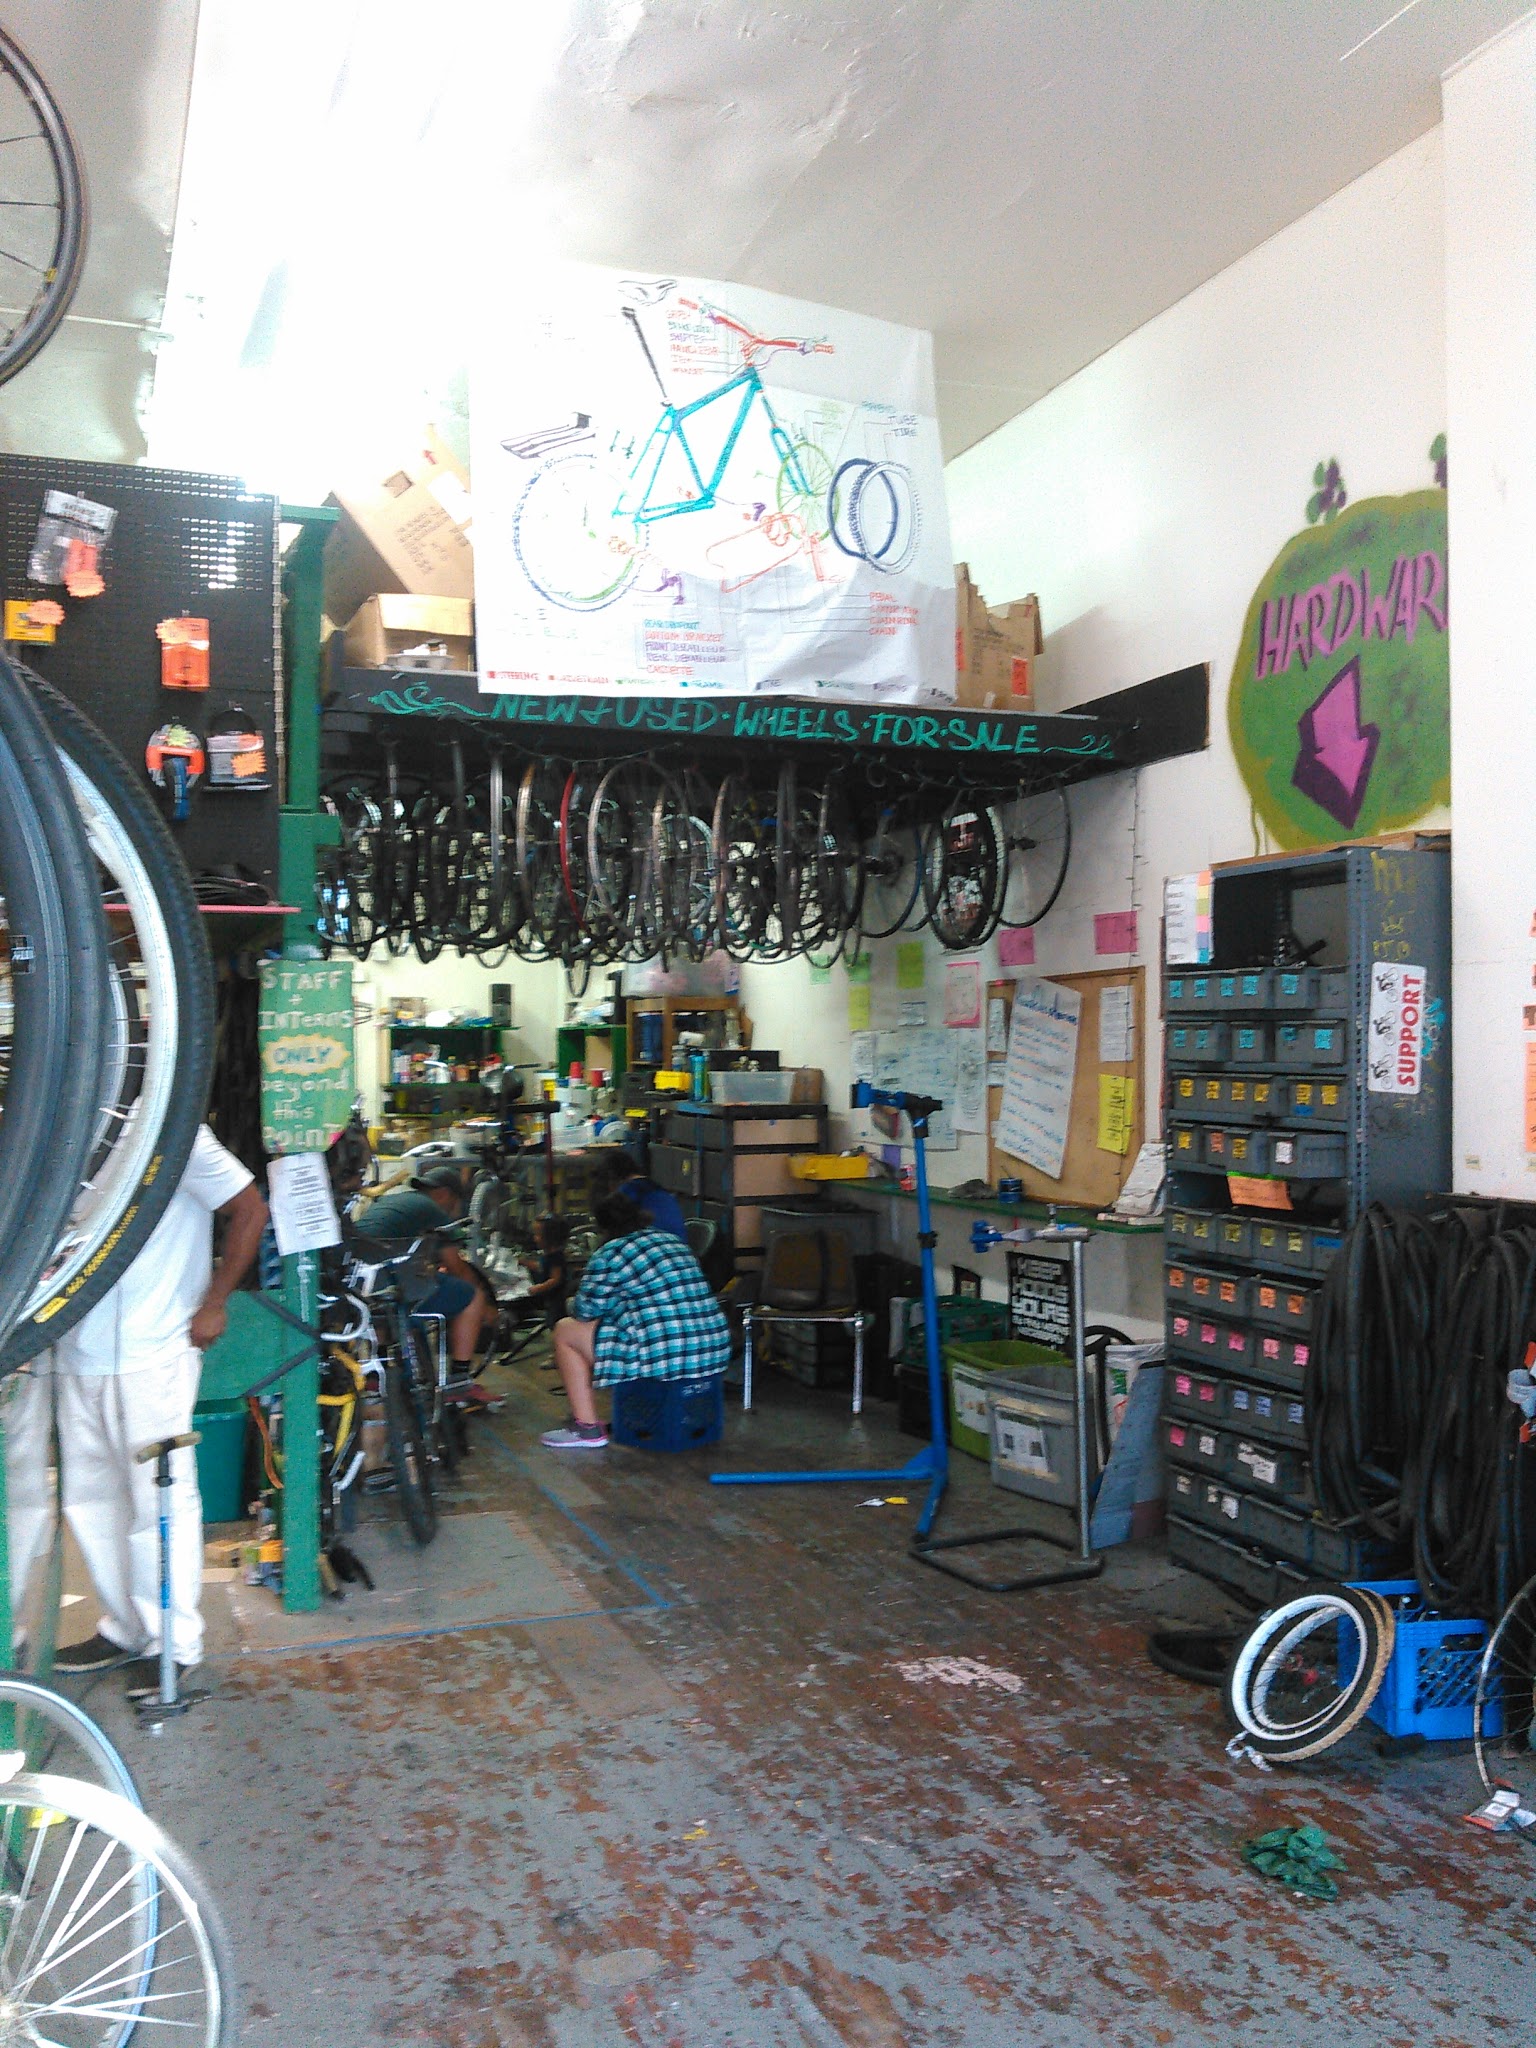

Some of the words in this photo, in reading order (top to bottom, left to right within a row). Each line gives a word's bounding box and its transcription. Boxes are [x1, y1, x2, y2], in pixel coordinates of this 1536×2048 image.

[490, 695, 578, 723] NEW
[615, 697, 718, 733] USED
[734, 701, 860, 743] WHEELS
[869, 712, 941, 748] FOR
[949, 718, 1041, 754] SALE
[261, 967, 345, 992] STAFF
[1397, 974, 1422, 1087] SUPPORT
